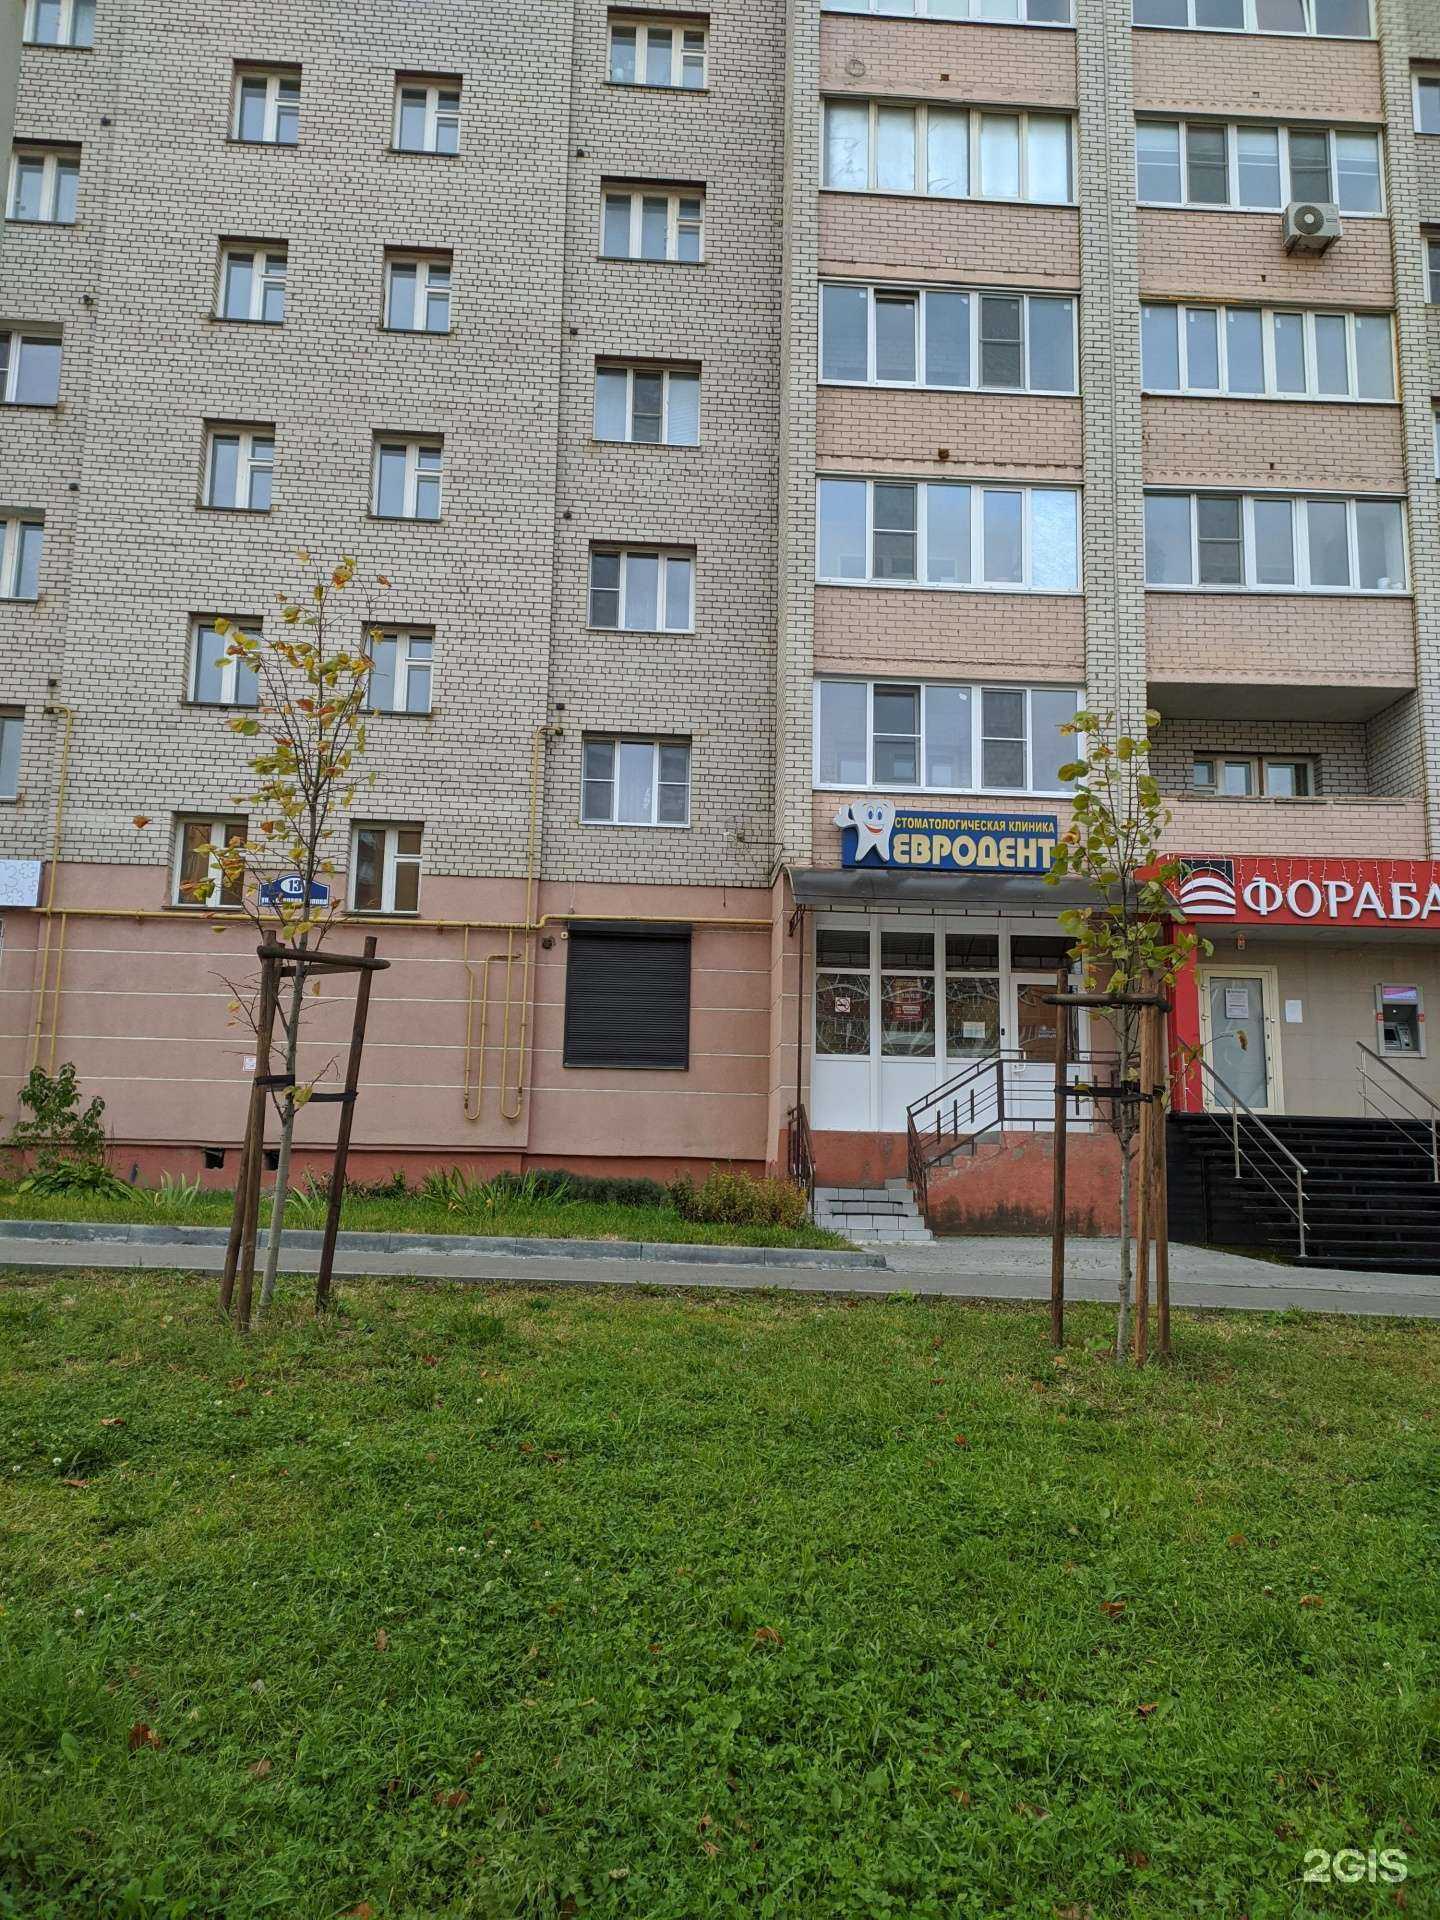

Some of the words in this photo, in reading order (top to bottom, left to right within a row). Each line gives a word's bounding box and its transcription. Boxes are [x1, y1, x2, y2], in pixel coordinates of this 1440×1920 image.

[894, 816, 1006, 832] СТОМАТОЛОГИЧЕСКАЯ
[1008, 820, 1055, 833] КЛИНИКА
[893, 833, 1056, 868] ЕВРОДЕНТ
